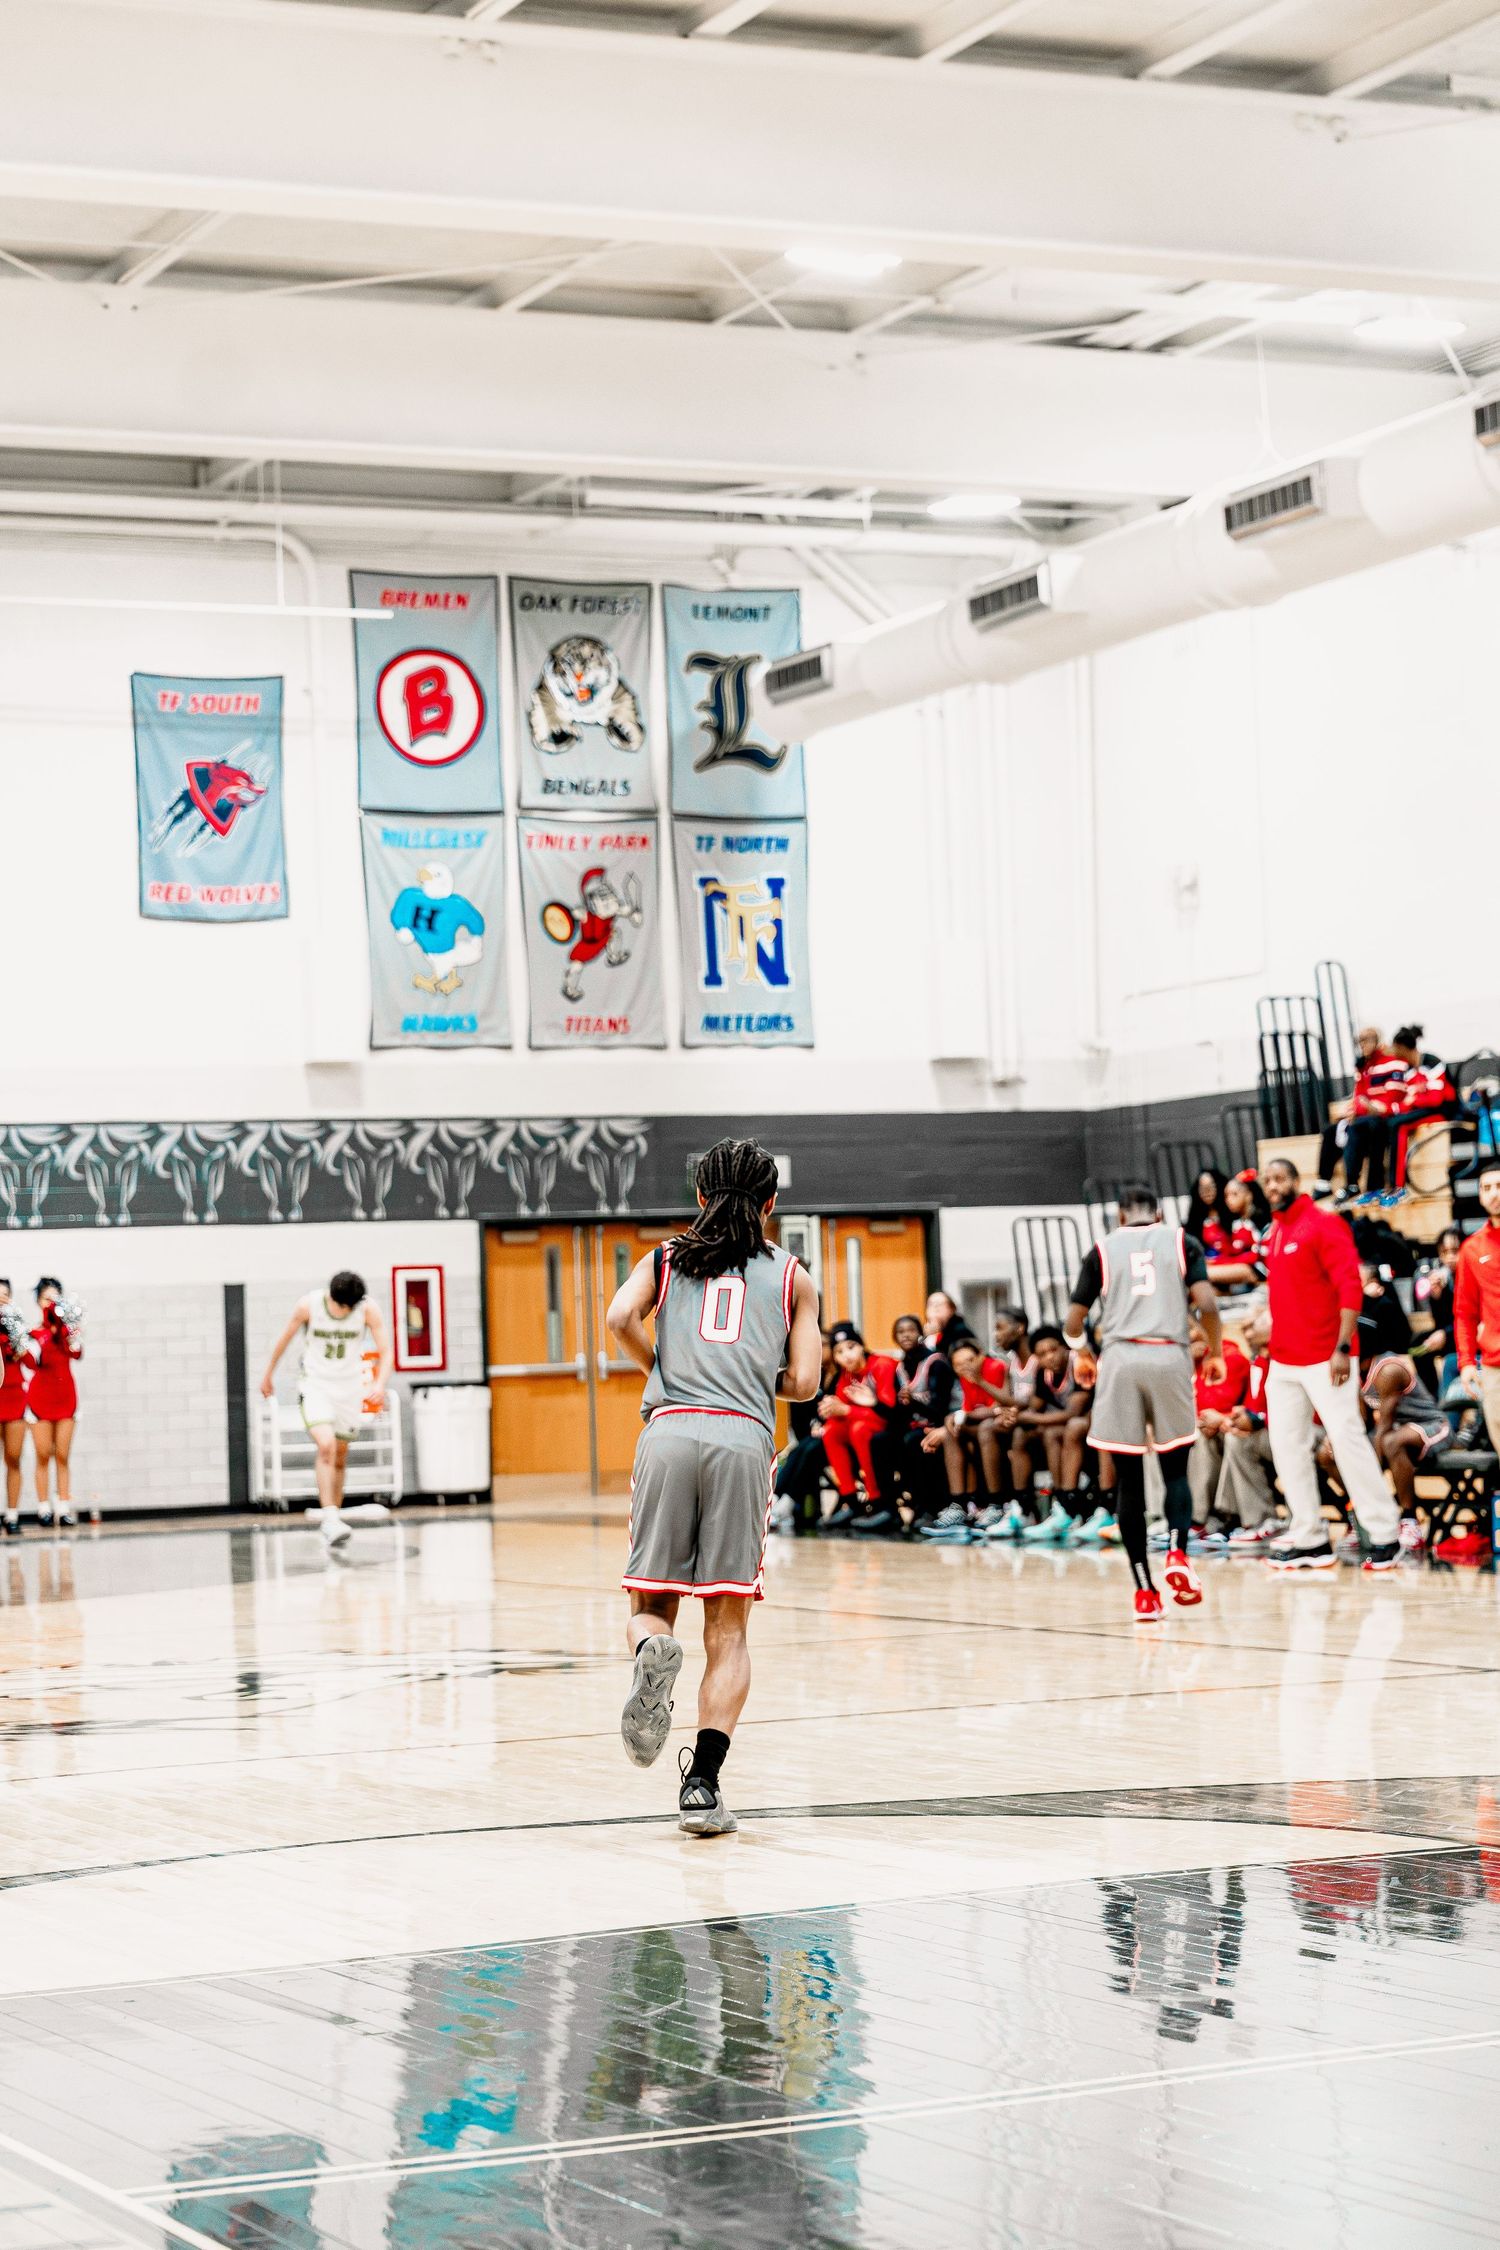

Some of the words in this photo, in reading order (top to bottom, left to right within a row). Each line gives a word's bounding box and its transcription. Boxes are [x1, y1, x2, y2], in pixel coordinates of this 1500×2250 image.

[380, 588, 470, 610] BREMEN
[519, 592, 562, 611] OAK
[569, 594, 641, 615] FOREST
[691, 604, 771, 622] LEMONT
[158, 691, 182, 712] TF
[188, 692, 261, 714] SOUTH
[404, 664, 454, 746] B
[686, 651, 787, 774] L
[541, 778, 632, 796] BENGALS
[526, 832, 592, 851] TINLEY
[598, 833, 652, 851] PARK
[696, 836, 715, 851] TF
[722, 836, 789, 853] NORTH
[149, 883, 191, 904] RED
[199, 883, 281, 905] WOLVES
[412, 905, 441, 932] H
[565, 1015, 631, 1034] TITANS
[701, 1014, 795, 1032] METEORS
[1130, 1251, 1157, 1296] 5
[699, 1275, 747, 1344] 0
